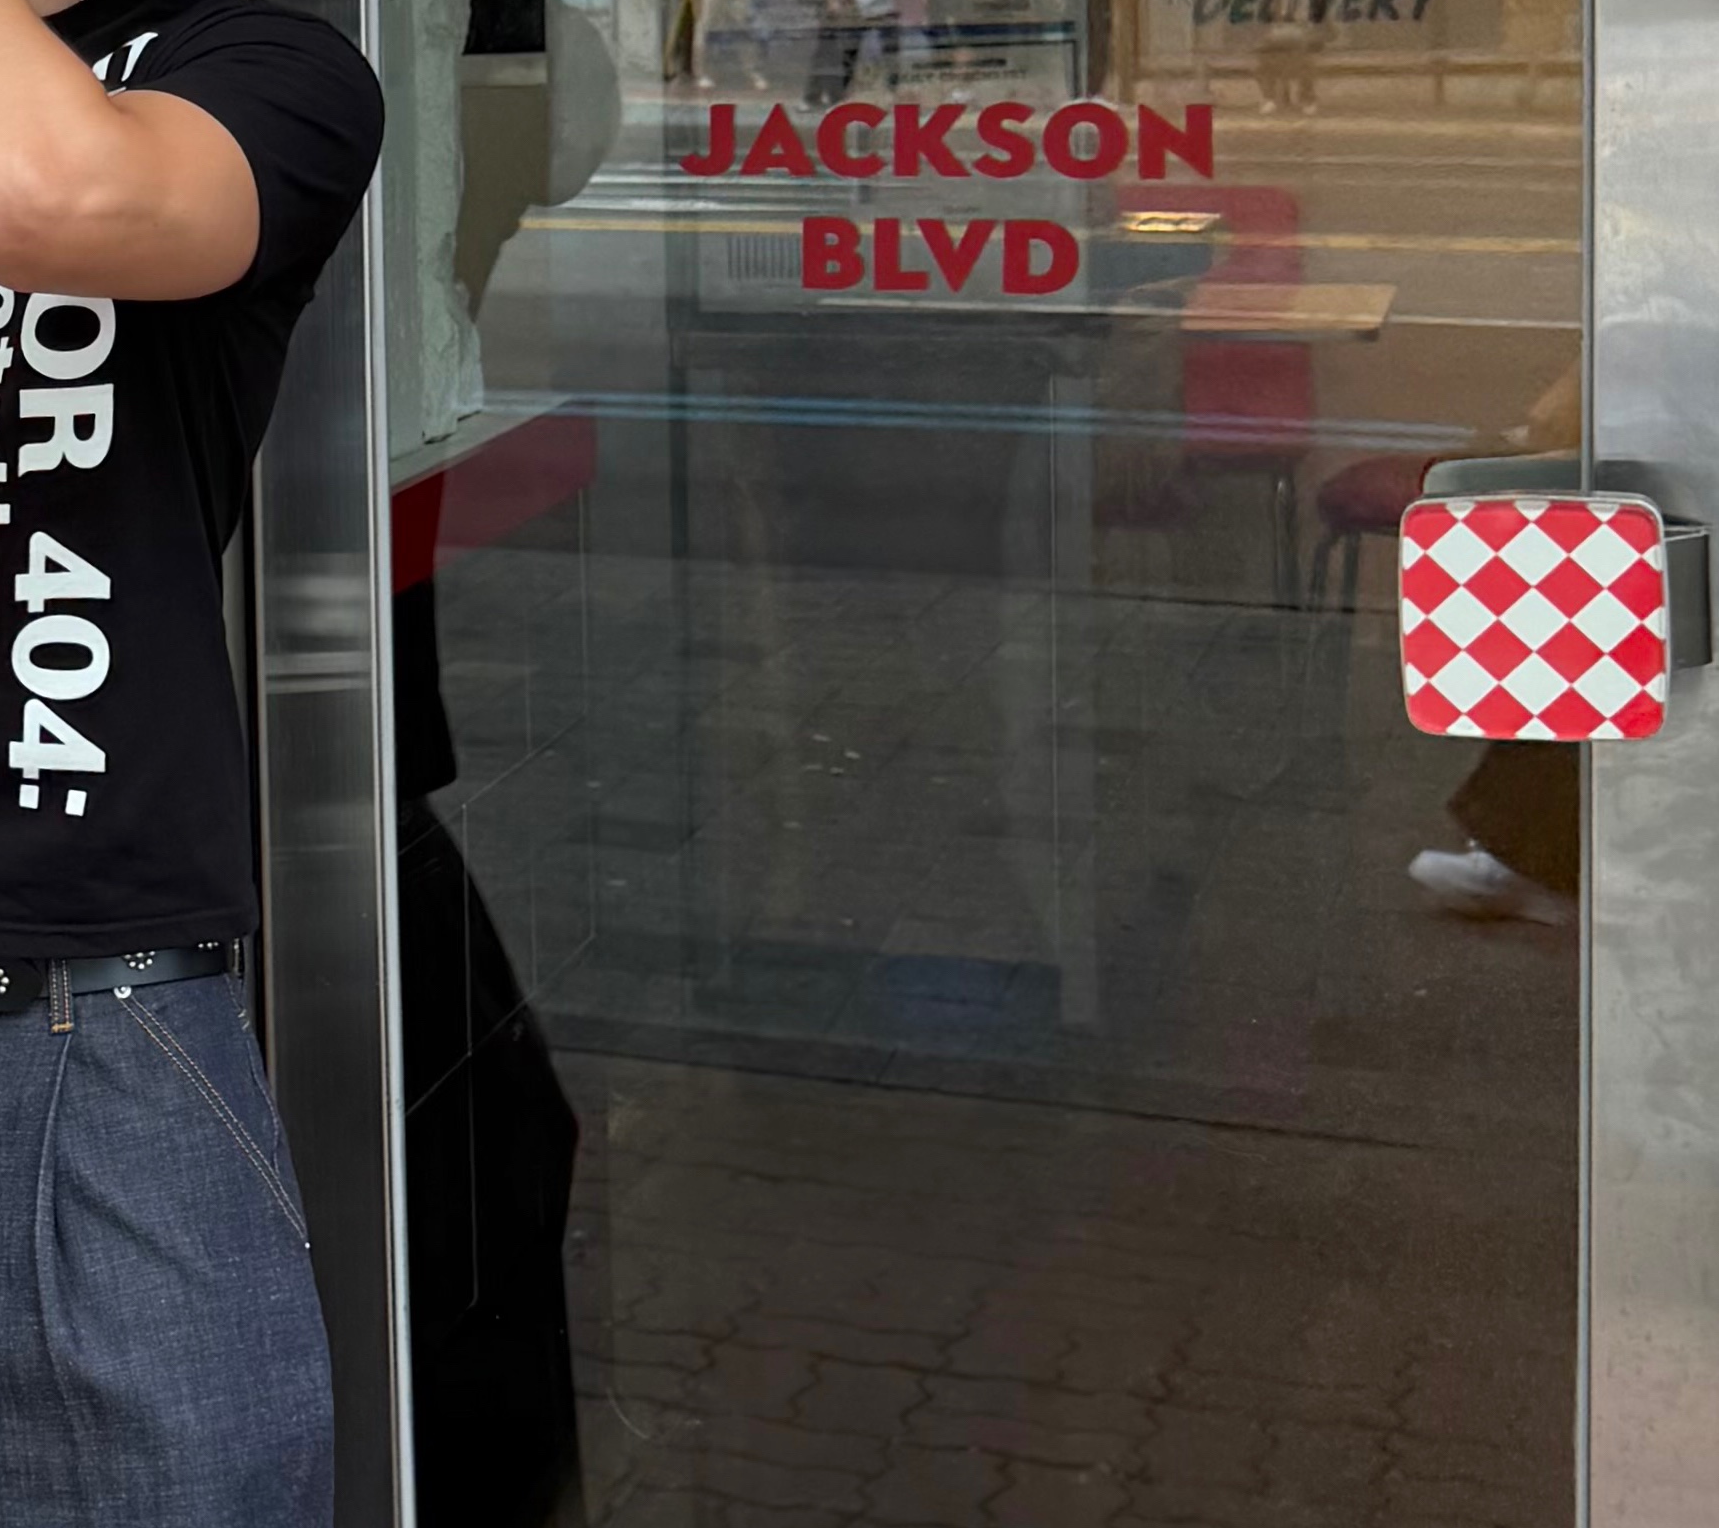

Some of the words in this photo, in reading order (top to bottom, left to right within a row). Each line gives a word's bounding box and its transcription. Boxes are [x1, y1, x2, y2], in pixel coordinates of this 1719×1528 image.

[681, 100, 1215, 180] JACKSON
[801, 215, 1081, 295] BLVD
[8, 529, 113, 818] 404:
